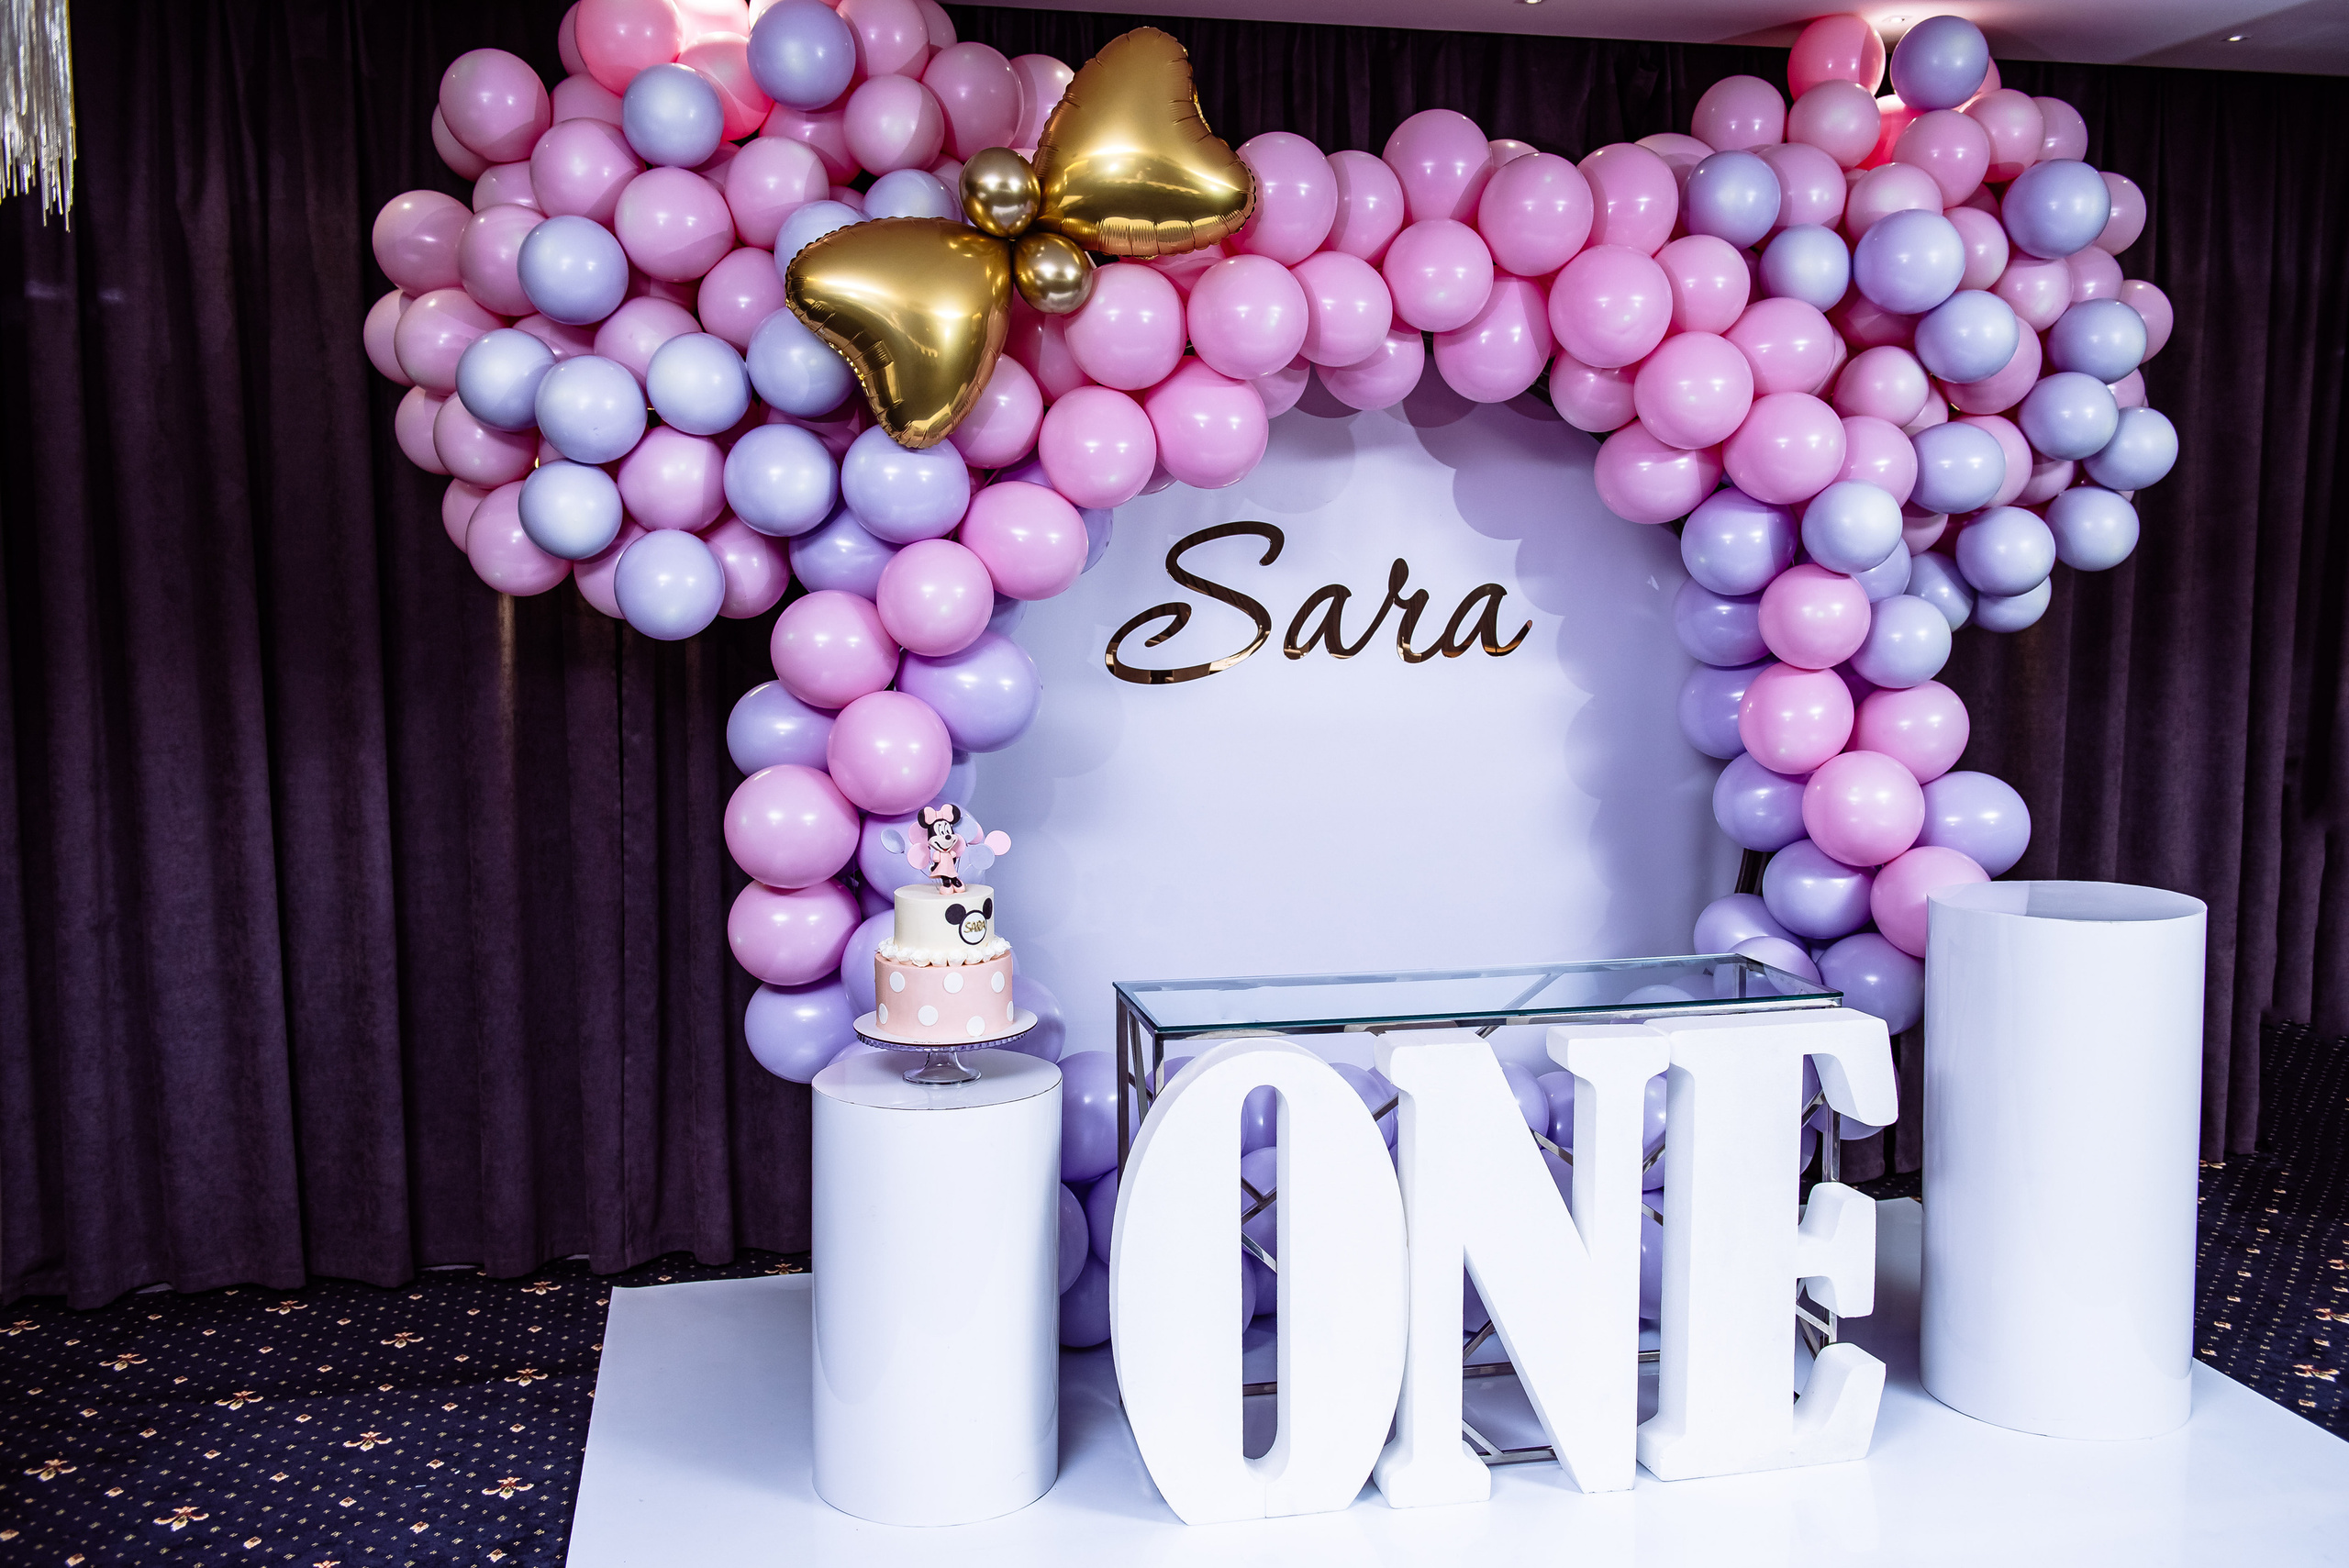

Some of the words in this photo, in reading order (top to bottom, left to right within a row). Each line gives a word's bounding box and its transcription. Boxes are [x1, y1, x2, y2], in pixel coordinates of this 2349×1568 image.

[1105, 520, 1533, 685] Sara
[963, 919, 986, 934] SARA
[1109, 1007, 1898, 1526] ONE
